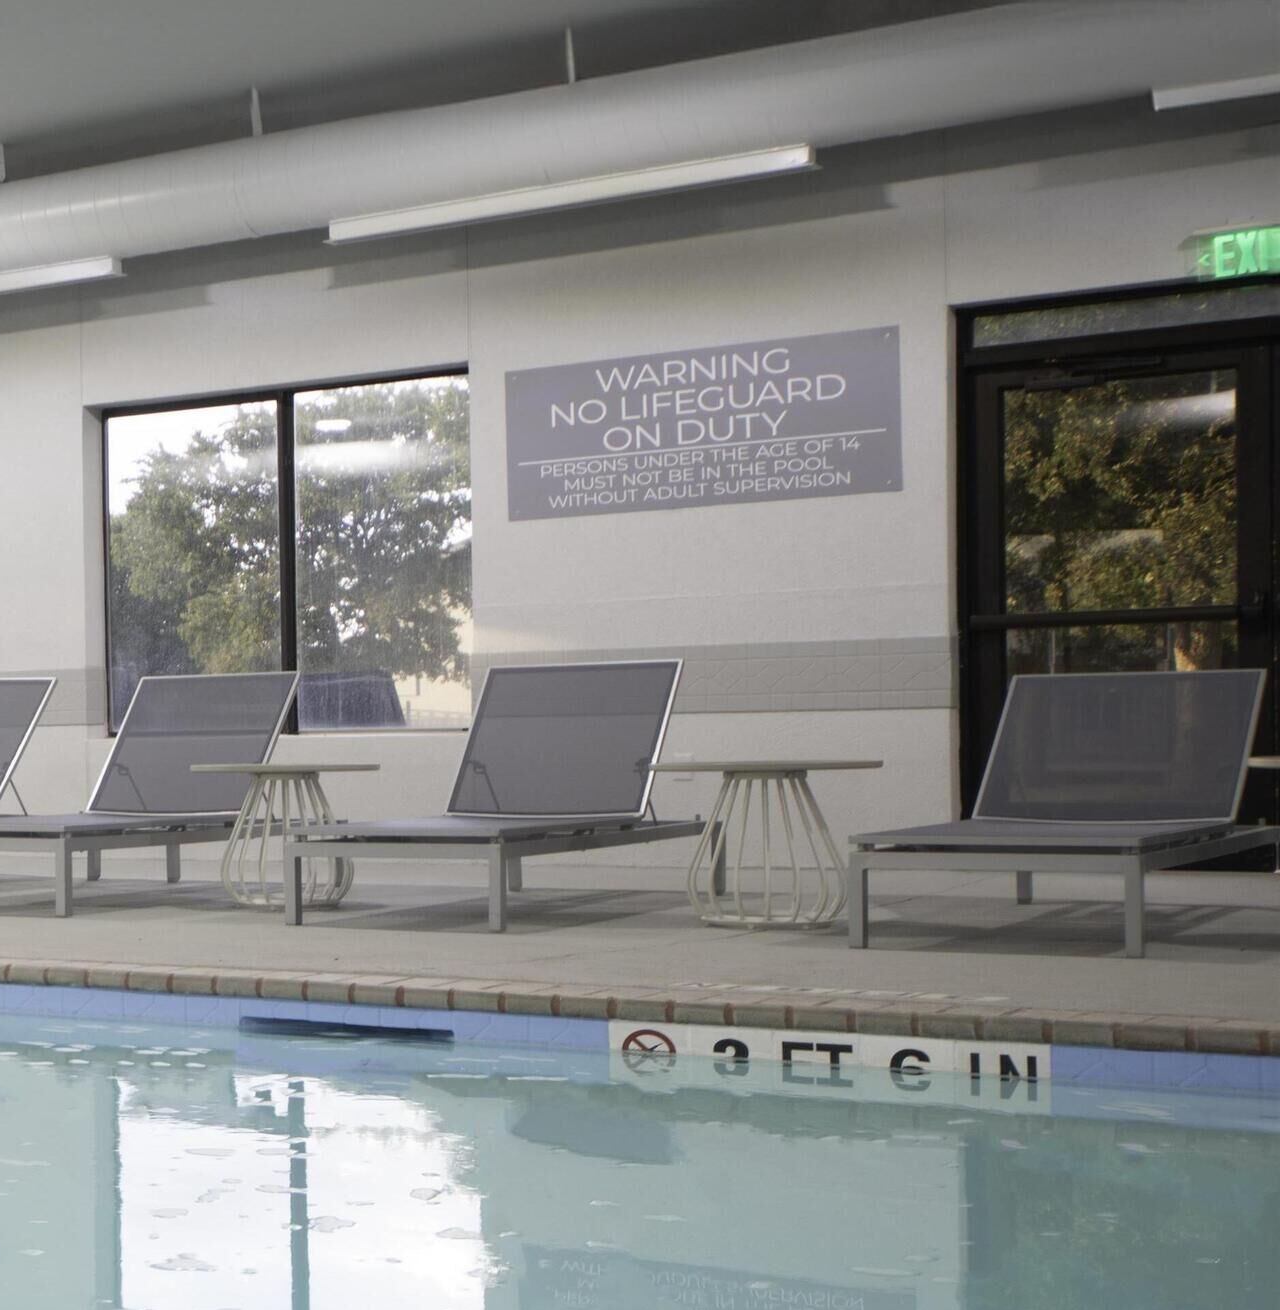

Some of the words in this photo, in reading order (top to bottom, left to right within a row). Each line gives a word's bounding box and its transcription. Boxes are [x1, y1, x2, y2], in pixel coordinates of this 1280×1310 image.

[1214, 230, 1280, 278] EXI
[596, 348, 790, 393] WARNING
[551, 400, 607, 428] NO
[621, 374, 846, 421] LIFEGUARD
[603, 423, 660, 451] ON
[678, 410, 787, 445] DUTY
[540, 457, 629, 478] PERSONS
[634, 451, 704, 470] UNDER
[710, 447, 751, 463] THE
[756, 442, 797, 459] AGE
[804, 439, 833, 454] OF
[839, 436, 860, 451] 14
[565, 475, 616, 491] MUST
[623, 471, 663, 486] NOT
[669, 468, 695, 483] BE
[702, 466, 720, 479] IN
[726, 462, 766, 478] THE
[774, 456, 833, 473] POOL
[549, 491, 636, 509] WITHOUT
[643, 483, 708, 501] ADULT
[714, 472, 851, 495] SUPERVISION
